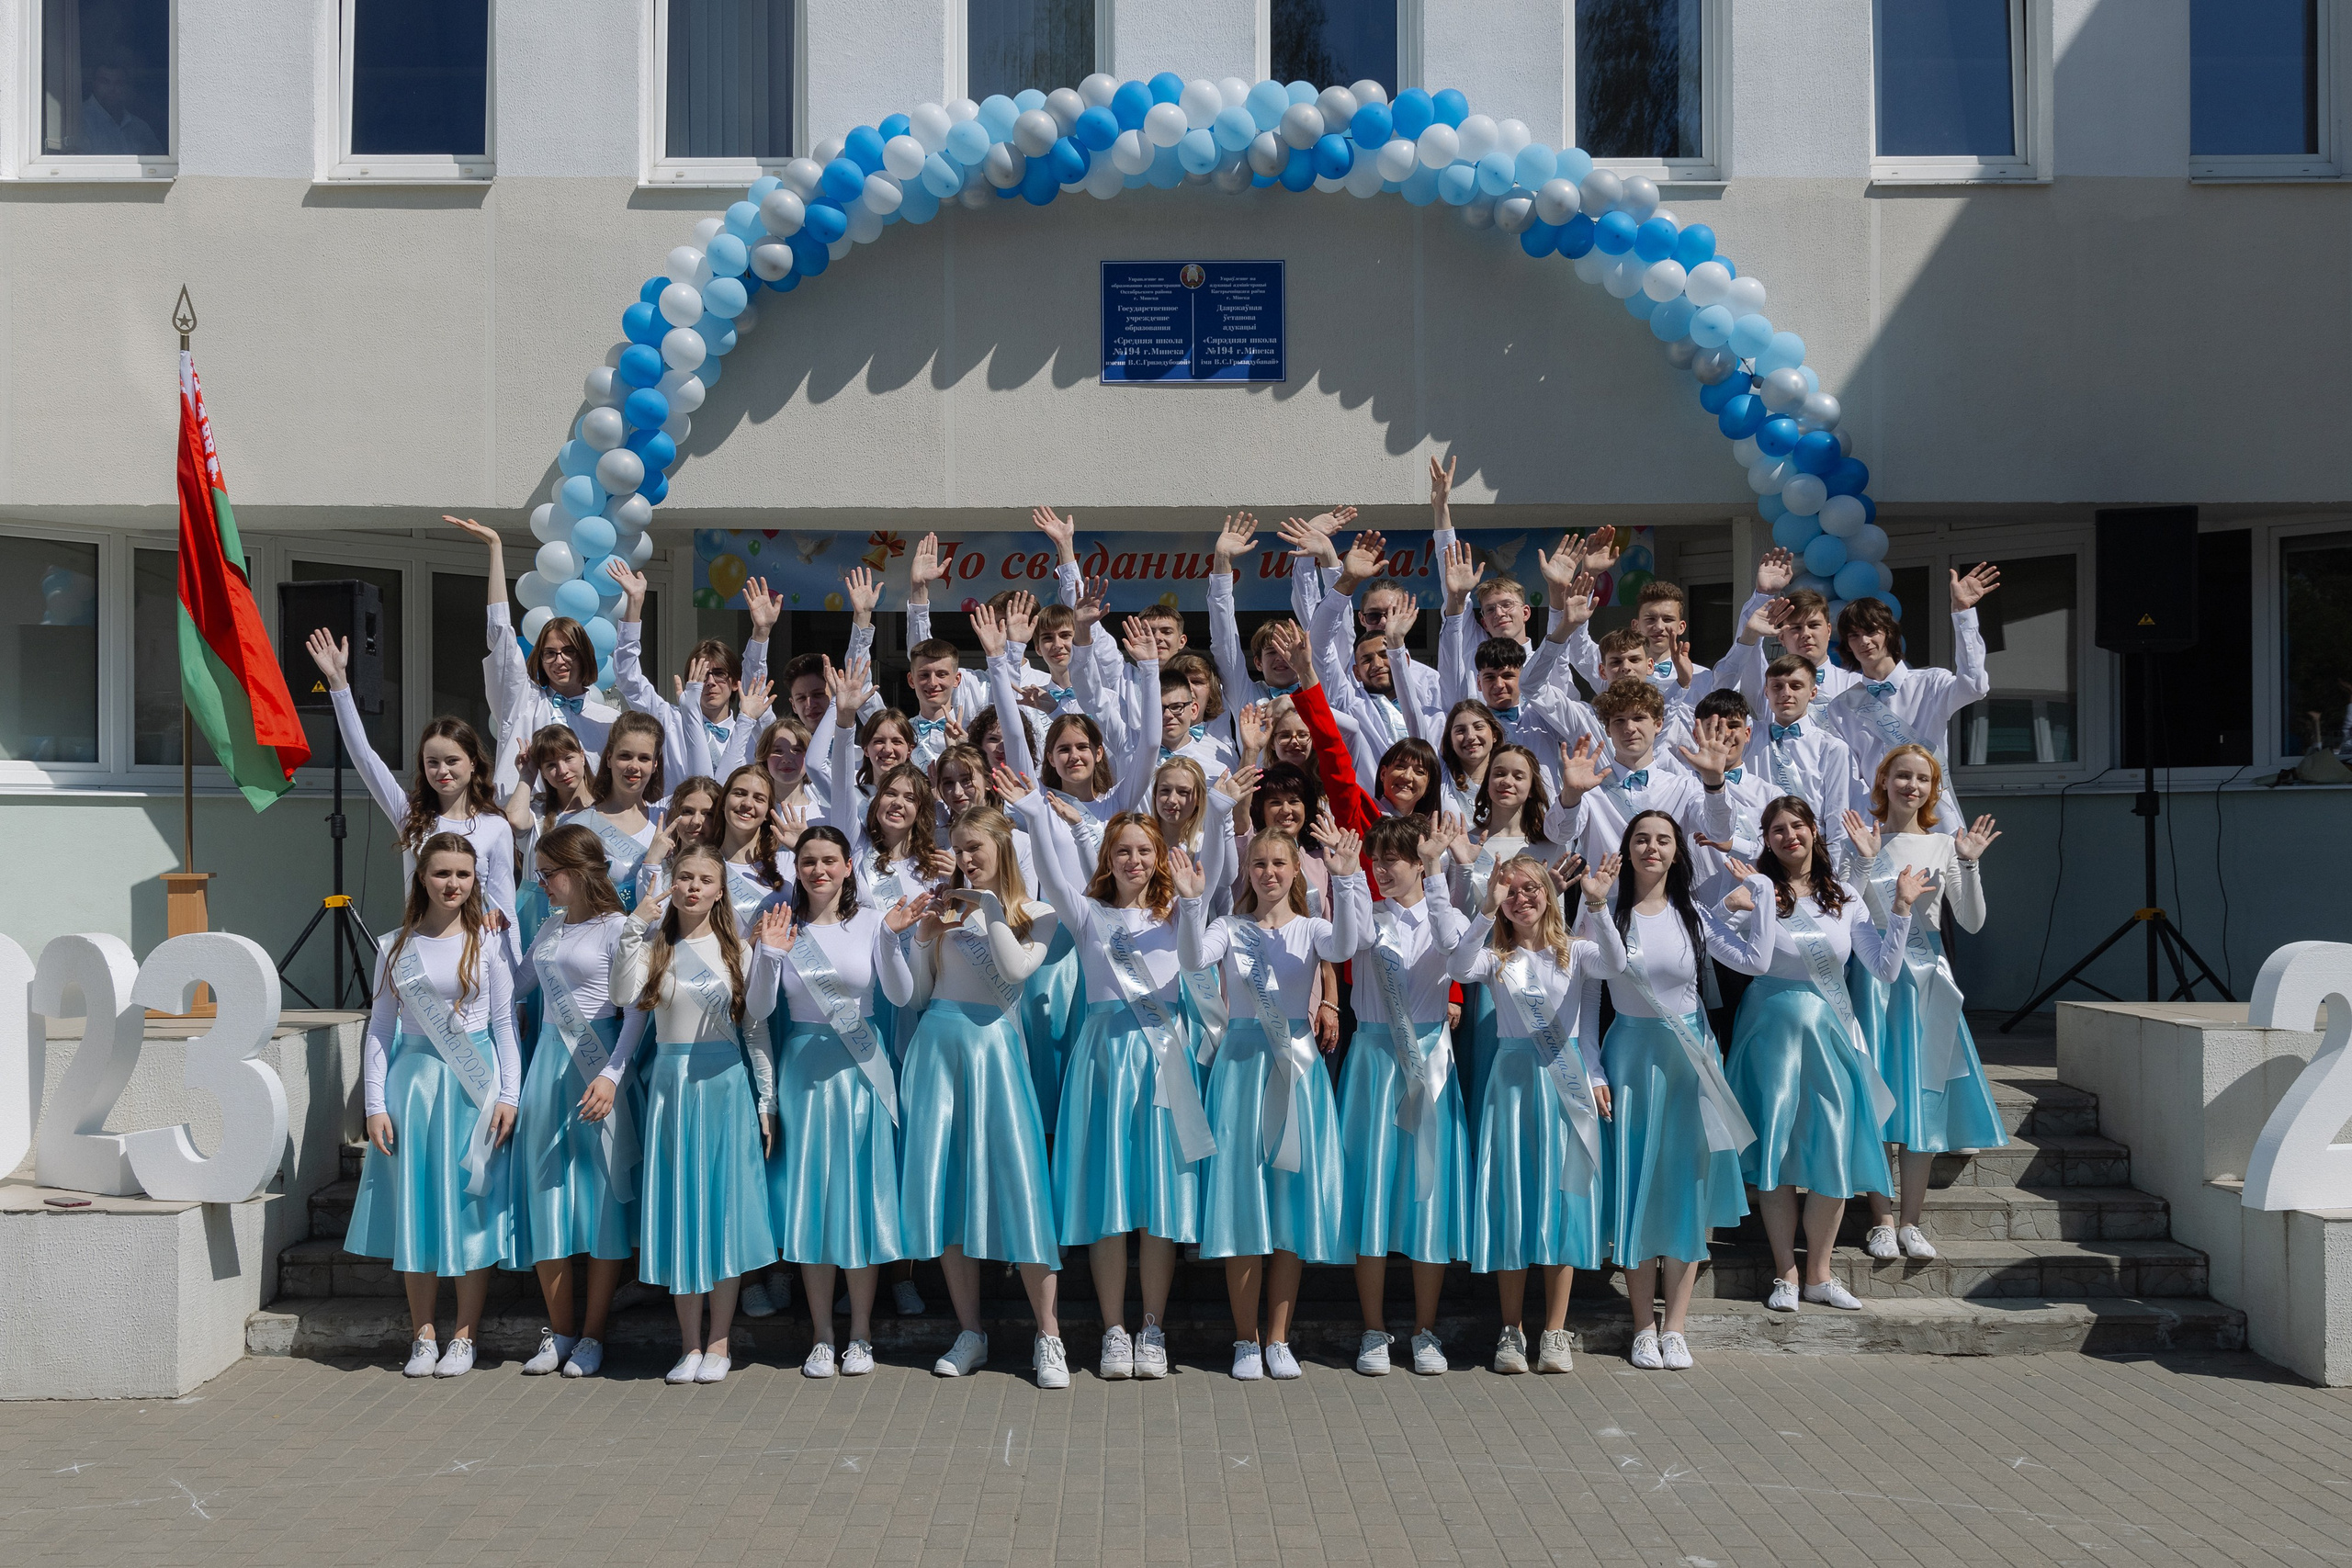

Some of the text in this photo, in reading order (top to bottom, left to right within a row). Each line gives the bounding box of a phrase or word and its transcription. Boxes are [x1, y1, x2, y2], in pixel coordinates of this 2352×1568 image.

[1216, 304, 1262, 312] Дзяржаўная
[1223, 313, 1256, 321] ўстанова
[1125, 324, 1171, 333] образования
[1222, 323, 1257, 332] адукацыі
[1114, 336, 1153, 345] «Средняя
[1203, 336, 1247, 345] «Сярэдняя
[1112, 346, 1140, 355] №194
[1204, 345, 1234, 355] №194
[1826, 983, 1851, 1022] 2024
[397, 953, 461, 1053] Выпускница
[456, 1046, 491, 1091] 2024
[840, 1010, 873, 1054] 2024
[1266, 1010, 1292, 1049] 2024
[1521, 985, 1568, 1073] Выпускница
[570, 1022, 603, 1067] 2024
